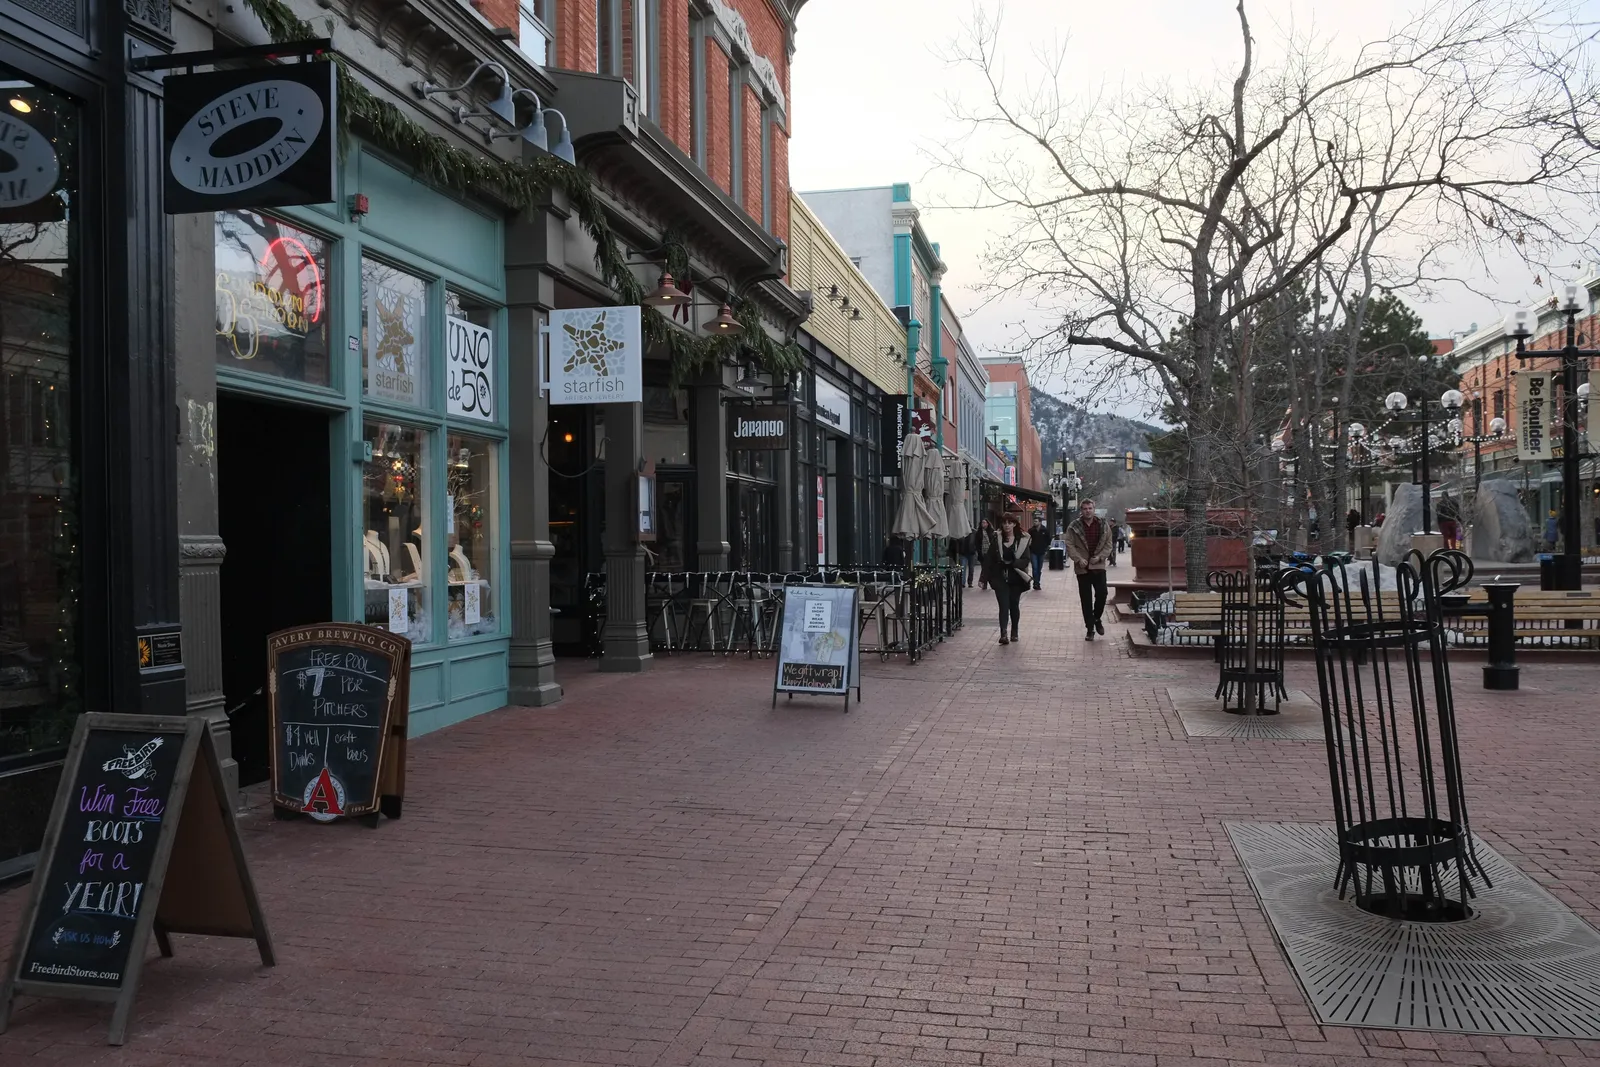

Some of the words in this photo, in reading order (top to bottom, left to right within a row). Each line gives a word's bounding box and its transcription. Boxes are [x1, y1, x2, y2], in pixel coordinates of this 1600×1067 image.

[198, 87, 279, 136] STEVE
[198, 128, 306, 188] MADDEN
[448, 320, 490, 369] UNO
[375, 371, 414, 395] starfish
[448, 370, 461, 401] de
[462, 368, 492, 418] 50
[563, 377, 624, 394] starfish
[1529, 377, 1544, 396] Be
[733, 416, 784, 438] Japango
[896, 403, 904, 439] American
[275, 632, 312, 647] AVERY
[318, 630, 376, 644] BREWING
[309, 649, 341, 667] FREE
[345, 653, 376, 673] POOL
[783, 664, 797, 675] We
[796, 664, 813, 680] gift
[814, 665, 843, 681] wrap!
[313, 698, 368, 718] PITCHERS
[108, 741, 158, 770] FREEBIRD
[80, 784, 115, 813] Win
[123, 787, 164, 816] Free
[301, 767, 345, 815] A
[83, 820, 145, 845] BOOTS
[80, 848, 103, 874] for
[112, 852, 130, 870] a
[62, 881, 144, 917] YEAR!
[30, 962, 120, 980] FreebirdStores.com
